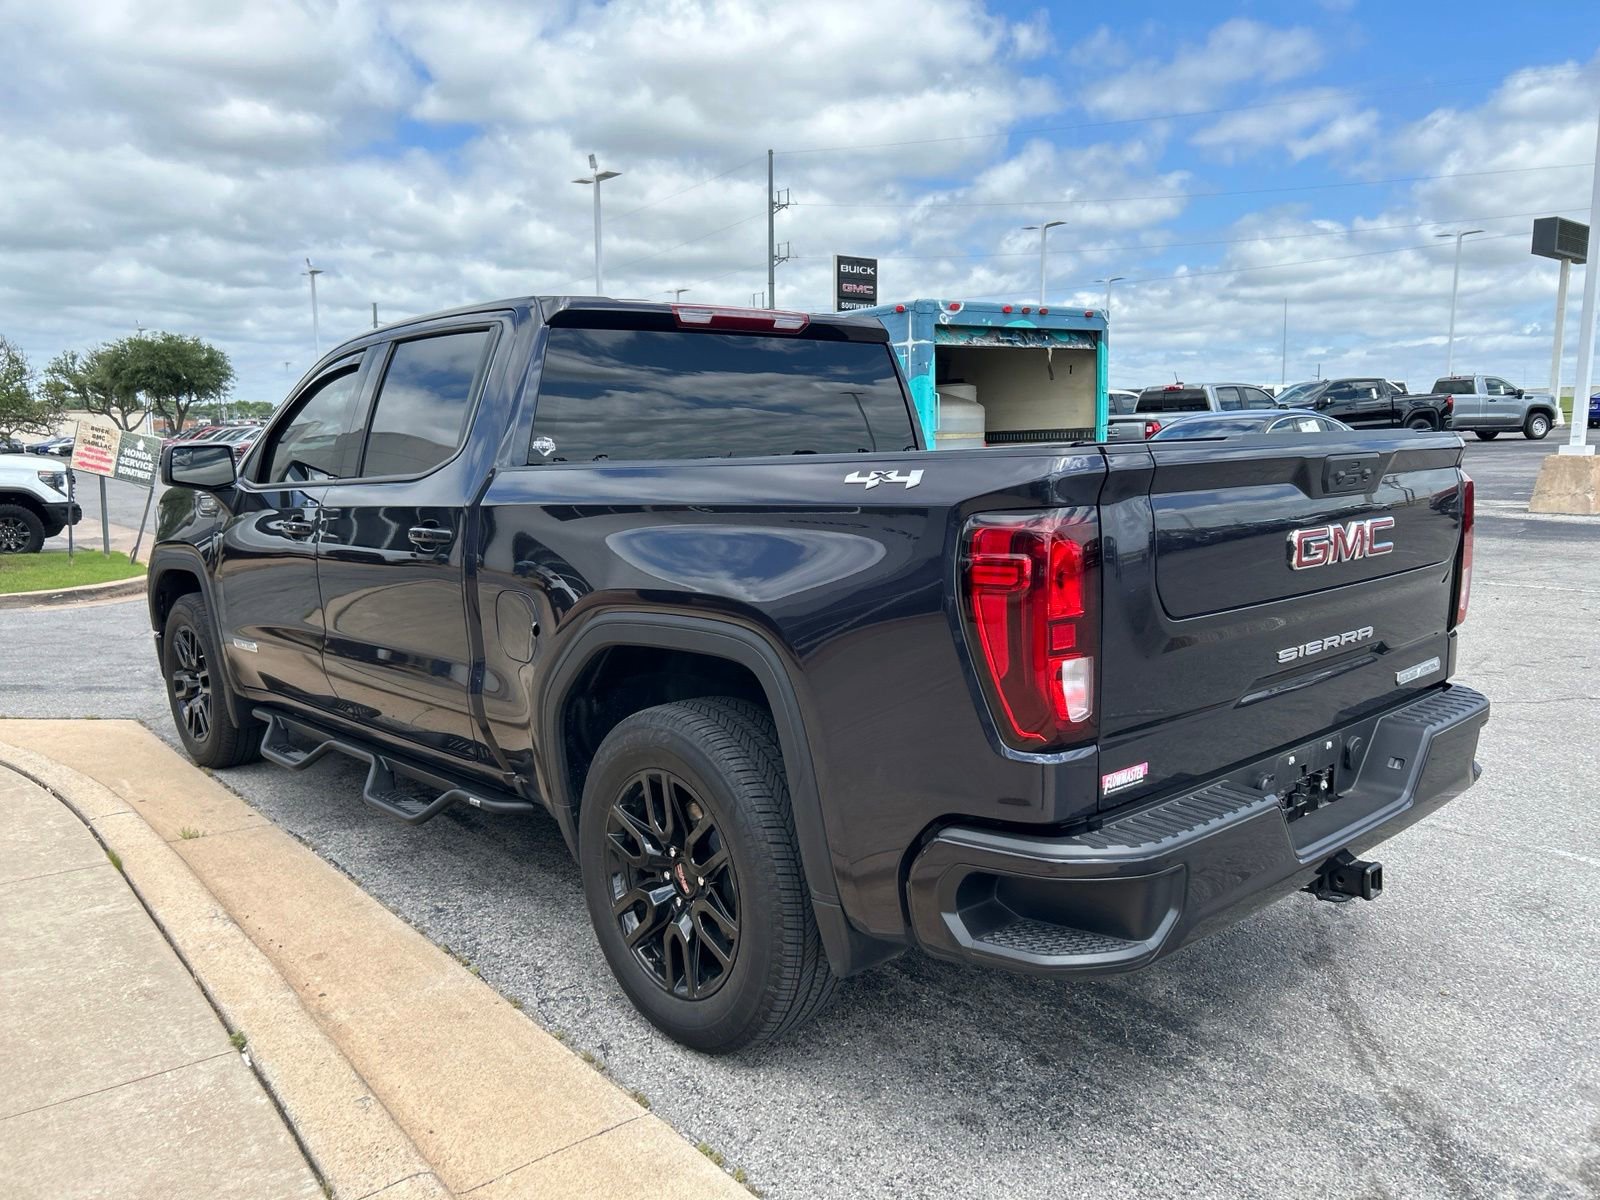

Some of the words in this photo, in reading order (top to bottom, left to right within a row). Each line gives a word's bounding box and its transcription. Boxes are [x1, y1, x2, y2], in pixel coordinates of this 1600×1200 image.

[840, 264, 875, 275] BUICK
[842, 283, 874, 294] GMC
[92, 433, 106, 441] GMC
[82, 438, 113, 450] CADILLAC
[124, 448, 152, 461] HONDA
[119, 456, 154, 471] SERVICE
[117, 465, 152, 480] DEPARTMENT
[1286, 516, 1395, 570] GMC
[1277, 626, 1374, 663] SIERRA
